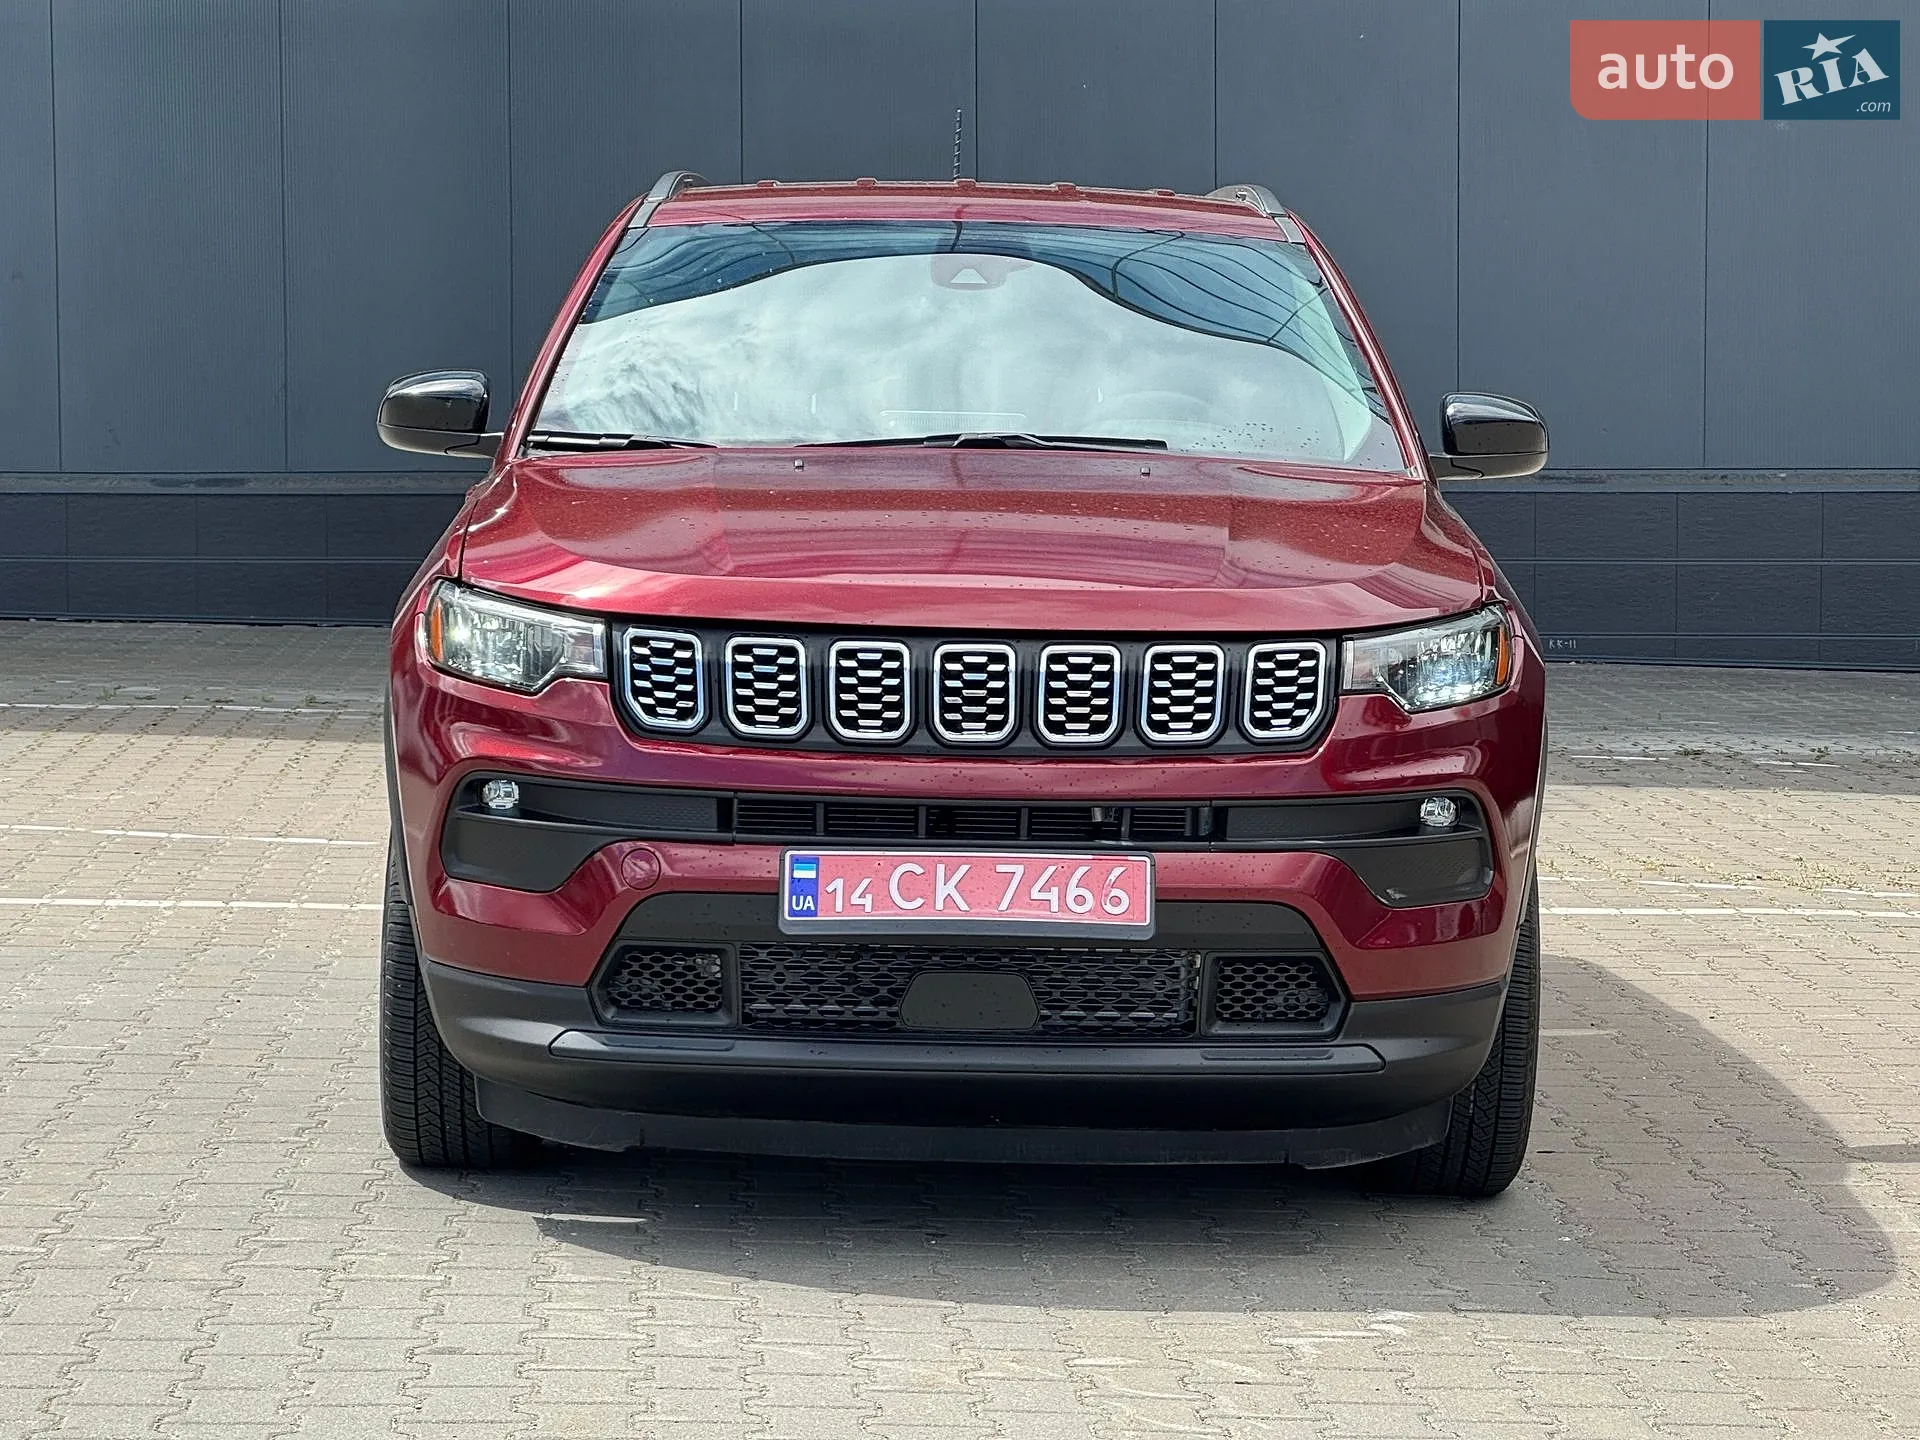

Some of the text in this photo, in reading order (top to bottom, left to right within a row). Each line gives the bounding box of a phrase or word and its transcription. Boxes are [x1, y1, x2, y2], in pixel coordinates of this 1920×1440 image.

[791, 895, 815, 911] UA
[825, 863, 1131, 915] 14 CK 7466
